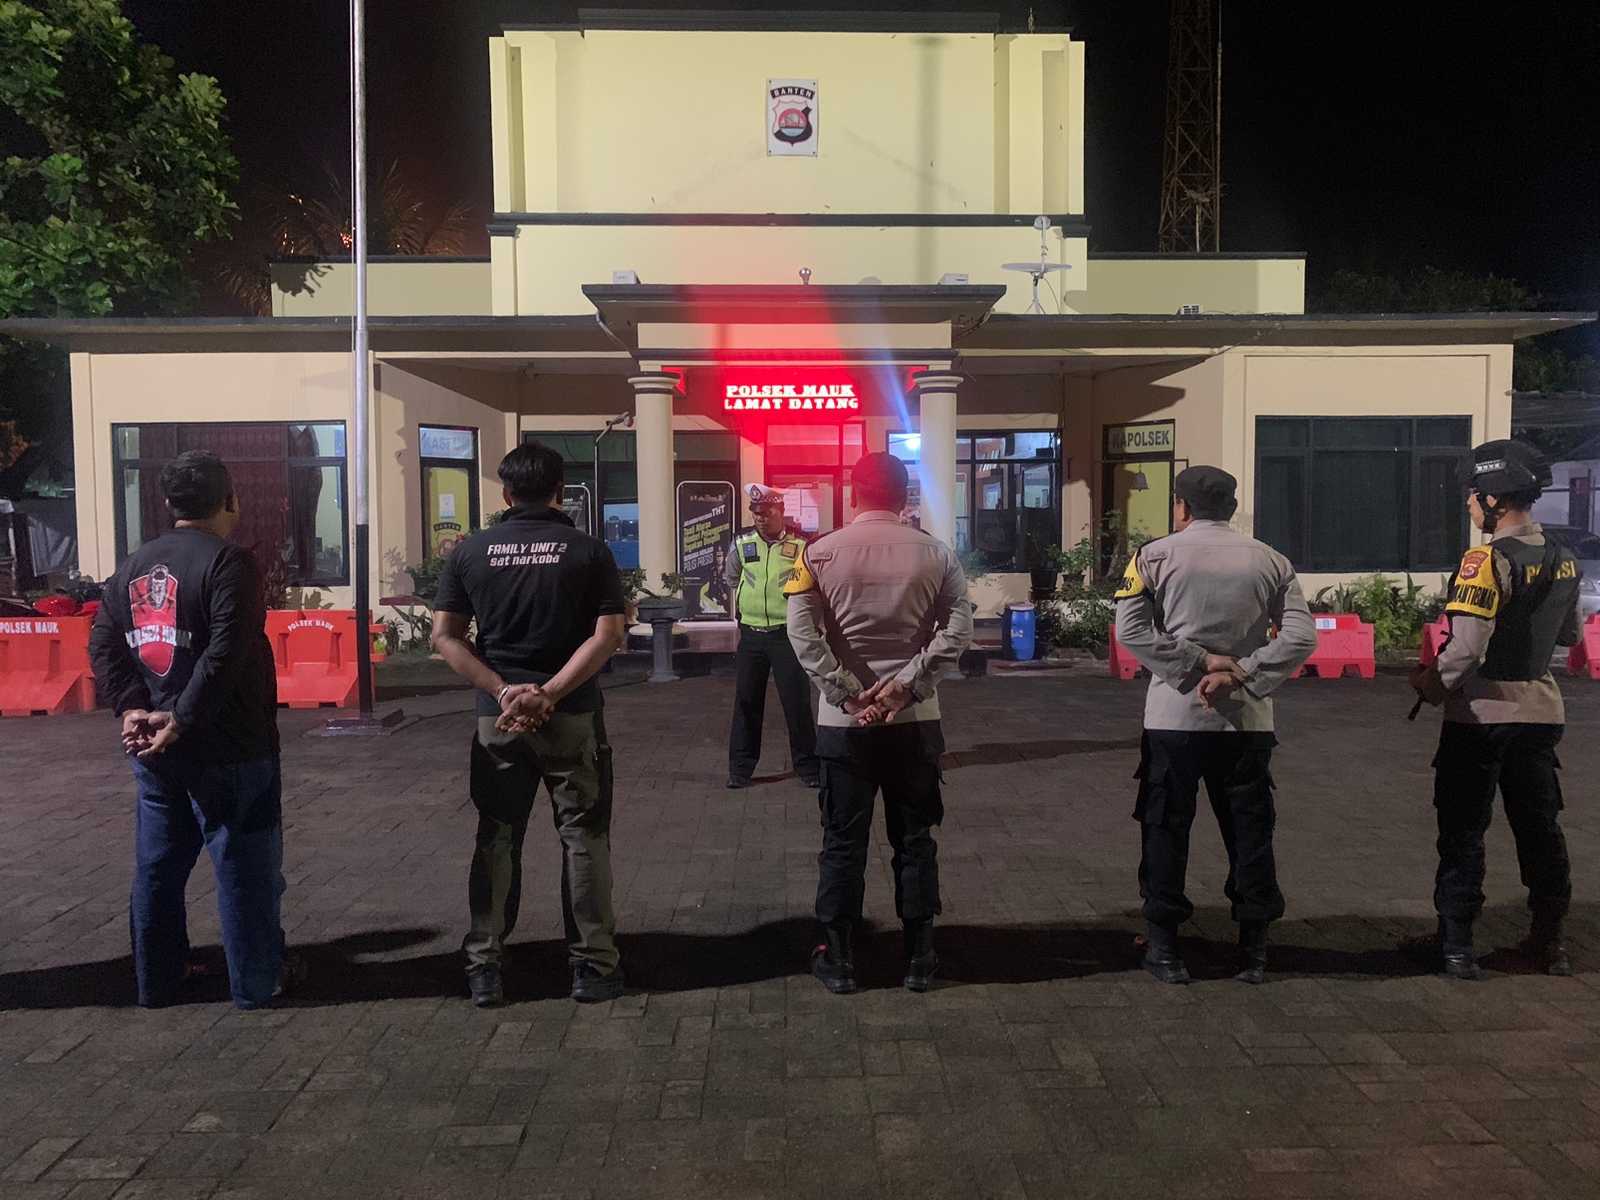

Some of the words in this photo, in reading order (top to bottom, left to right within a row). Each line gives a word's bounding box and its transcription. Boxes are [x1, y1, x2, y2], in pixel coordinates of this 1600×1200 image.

[773, 87, 812, 98] BANTEN
[726, 384, 796, 397] POLSEK
[802, 384, 855, 397] MAUK
[724, 398, 783, 409] LAMAT
[788, 398, 859, 409] DATANG
[487, 543, 528, 555] FAMILY
[530, 542, 558, 553] UNIT
[558, 543, 568, 553] 2
[489, 555, 511, 567] sat
[34, 621, 60, 634] MAUK
